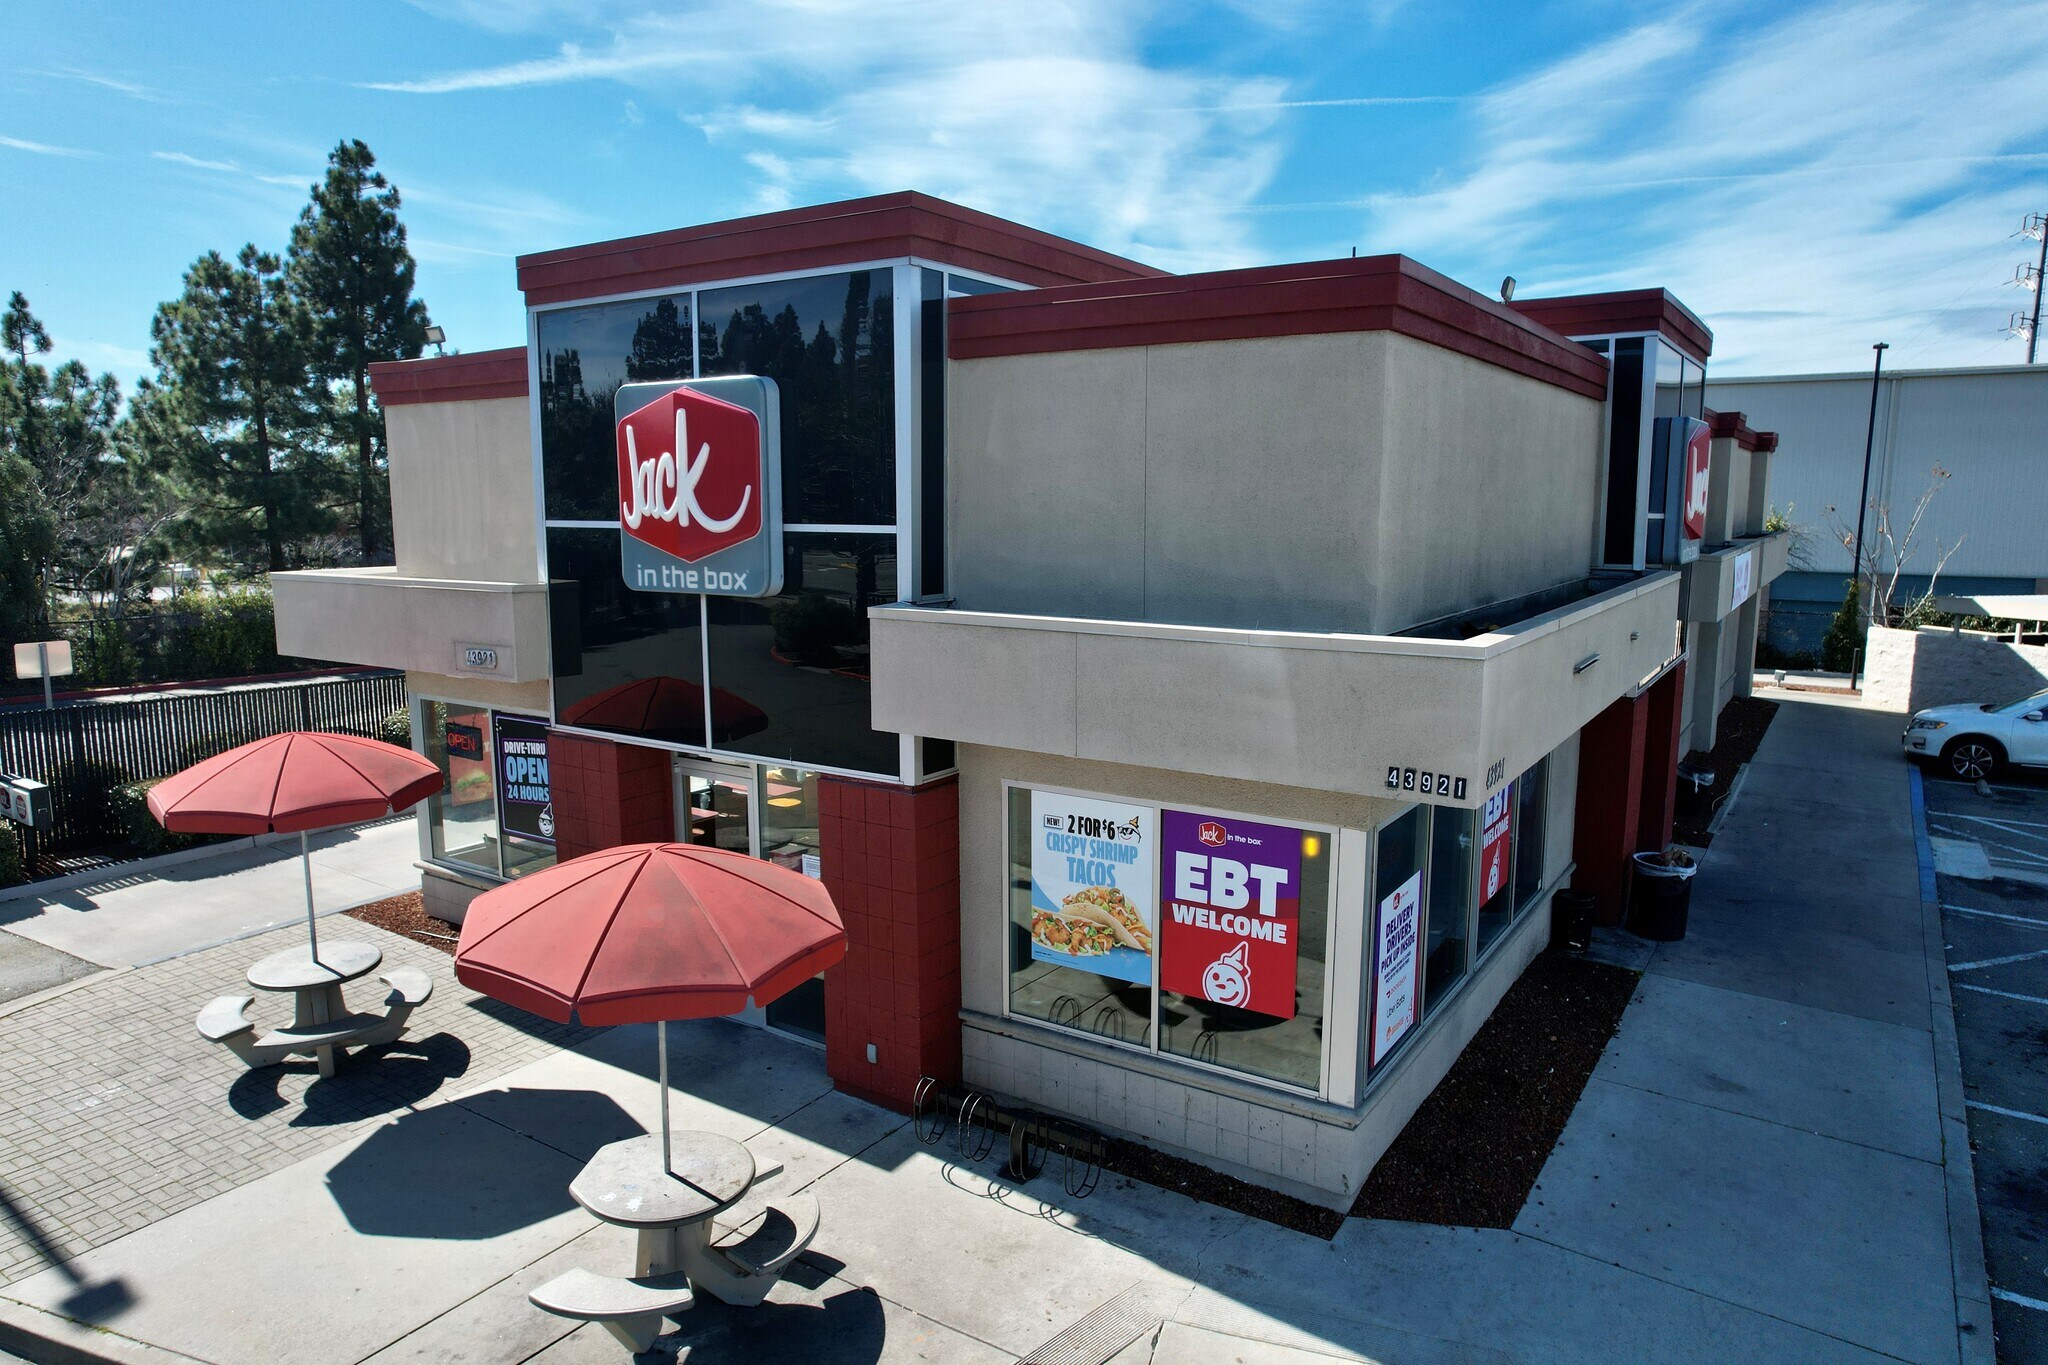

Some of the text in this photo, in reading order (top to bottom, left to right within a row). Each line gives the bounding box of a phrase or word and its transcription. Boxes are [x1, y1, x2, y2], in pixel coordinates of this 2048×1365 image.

[623, 408, 751, 533] Jack
[637, 564, 747, 591] in the box
[447, 732, 475, 752] OPEN
[504, 741, 546, 756] DRIVE-THRU
[506, 756, 549, 785] OPEN
[1388, 767, 1465, 799] 43921
[1486, 757, 1505, 790] 43921
[507, 784, 549, 802] 24 HOURS
[1484, 784, 1508, 830] EBT
[1046, 814, 1116, 840] NEW! 2 FOR $6
[1200, 825, 1261, 846] Jack in the box
[1483, 814, 1509, 849] WELCOME
[1045, 831, 1138, 865] CRISPY SHRIMP
[1066, 856, 1116, 888] TACOS
[1174, 850, 1288, 917] EBT
[1171, 902, 1287, 944] WELCOME
[1385, 901, 1414, 940] DELIVERY
[1386, 918, 1412, 954] DRIVERS
[1381, 953, 1393, 974] PICK
[1393, 945, 1400, 962] UP
[1400, 931, 1415, 955] INSIDE
